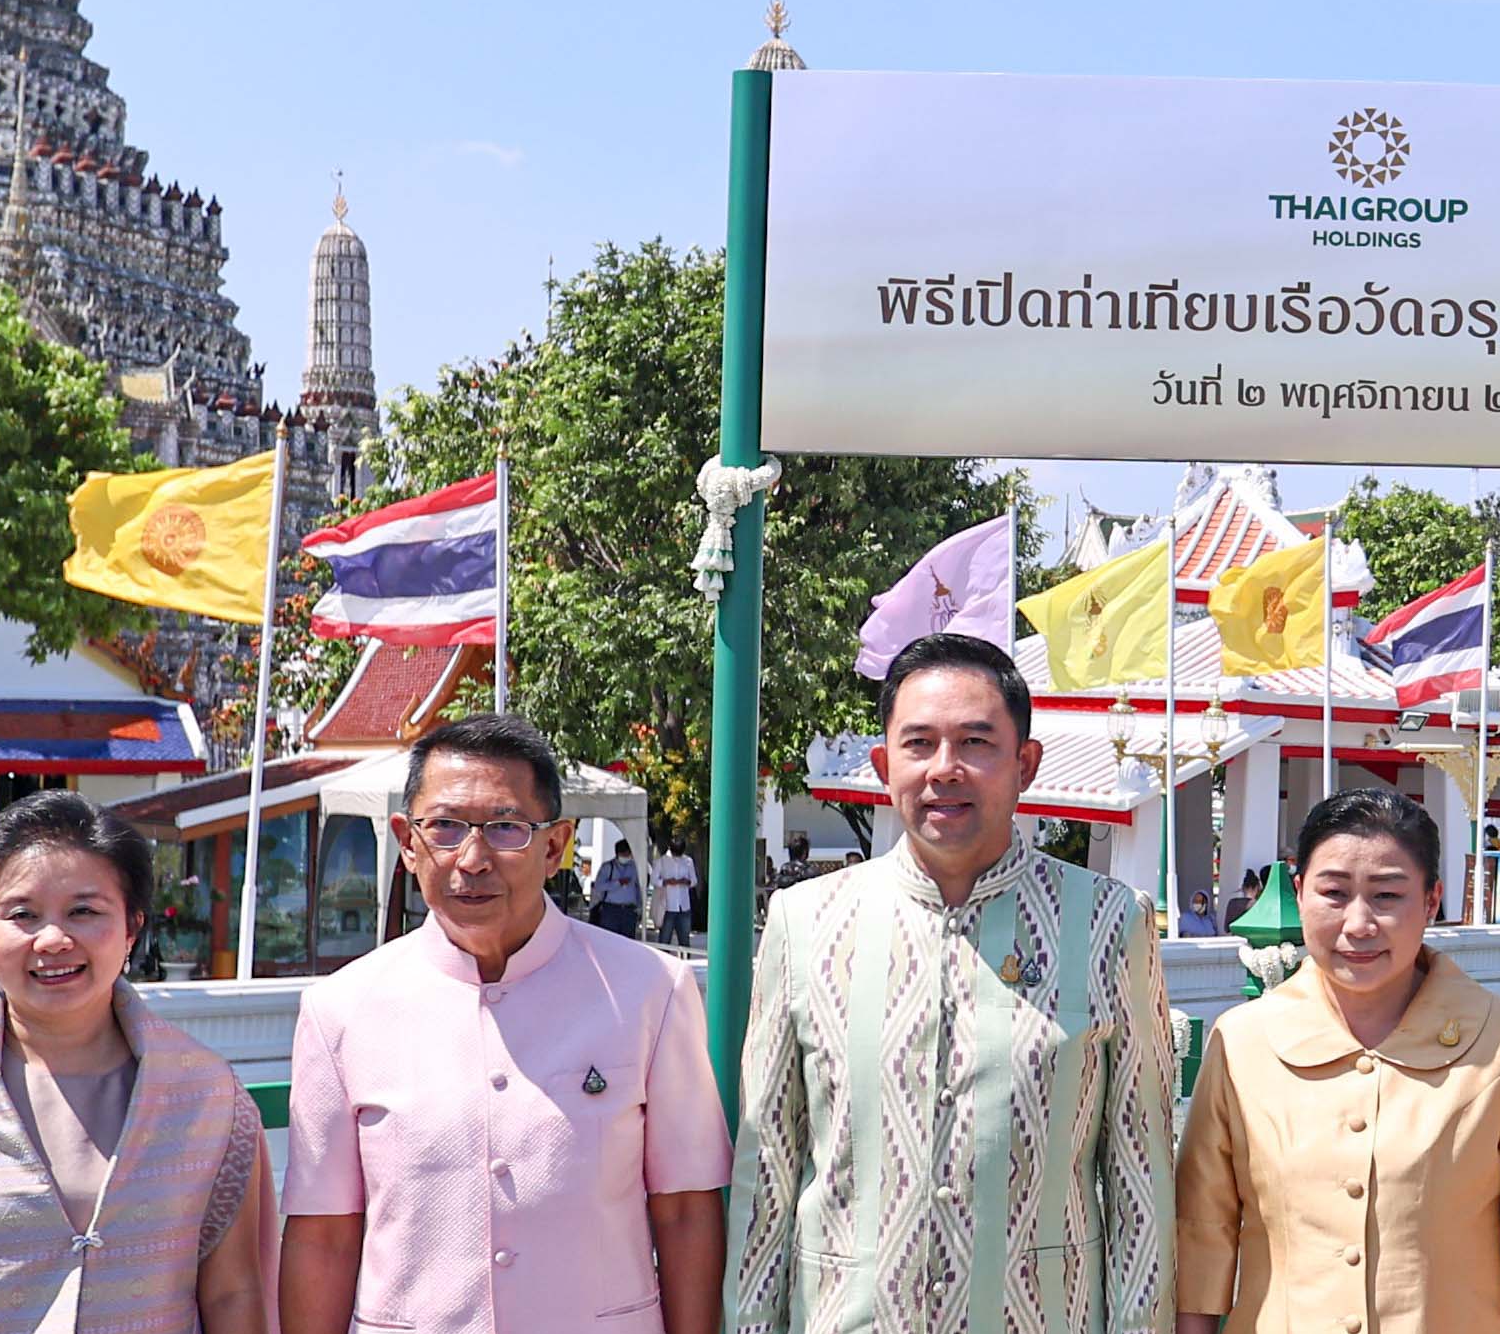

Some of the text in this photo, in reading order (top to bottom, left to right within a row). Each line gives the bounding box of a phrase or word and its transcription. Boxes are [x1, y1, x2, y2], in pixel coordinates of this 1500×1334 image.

[1312, 230, 1422, 249] HOLDINGS
[1152, 362, 1223, 407] วันที่
[1237, 378, 1266, 407] ๒
[1280, 379, 1470, 419] พฤศจิกายน
